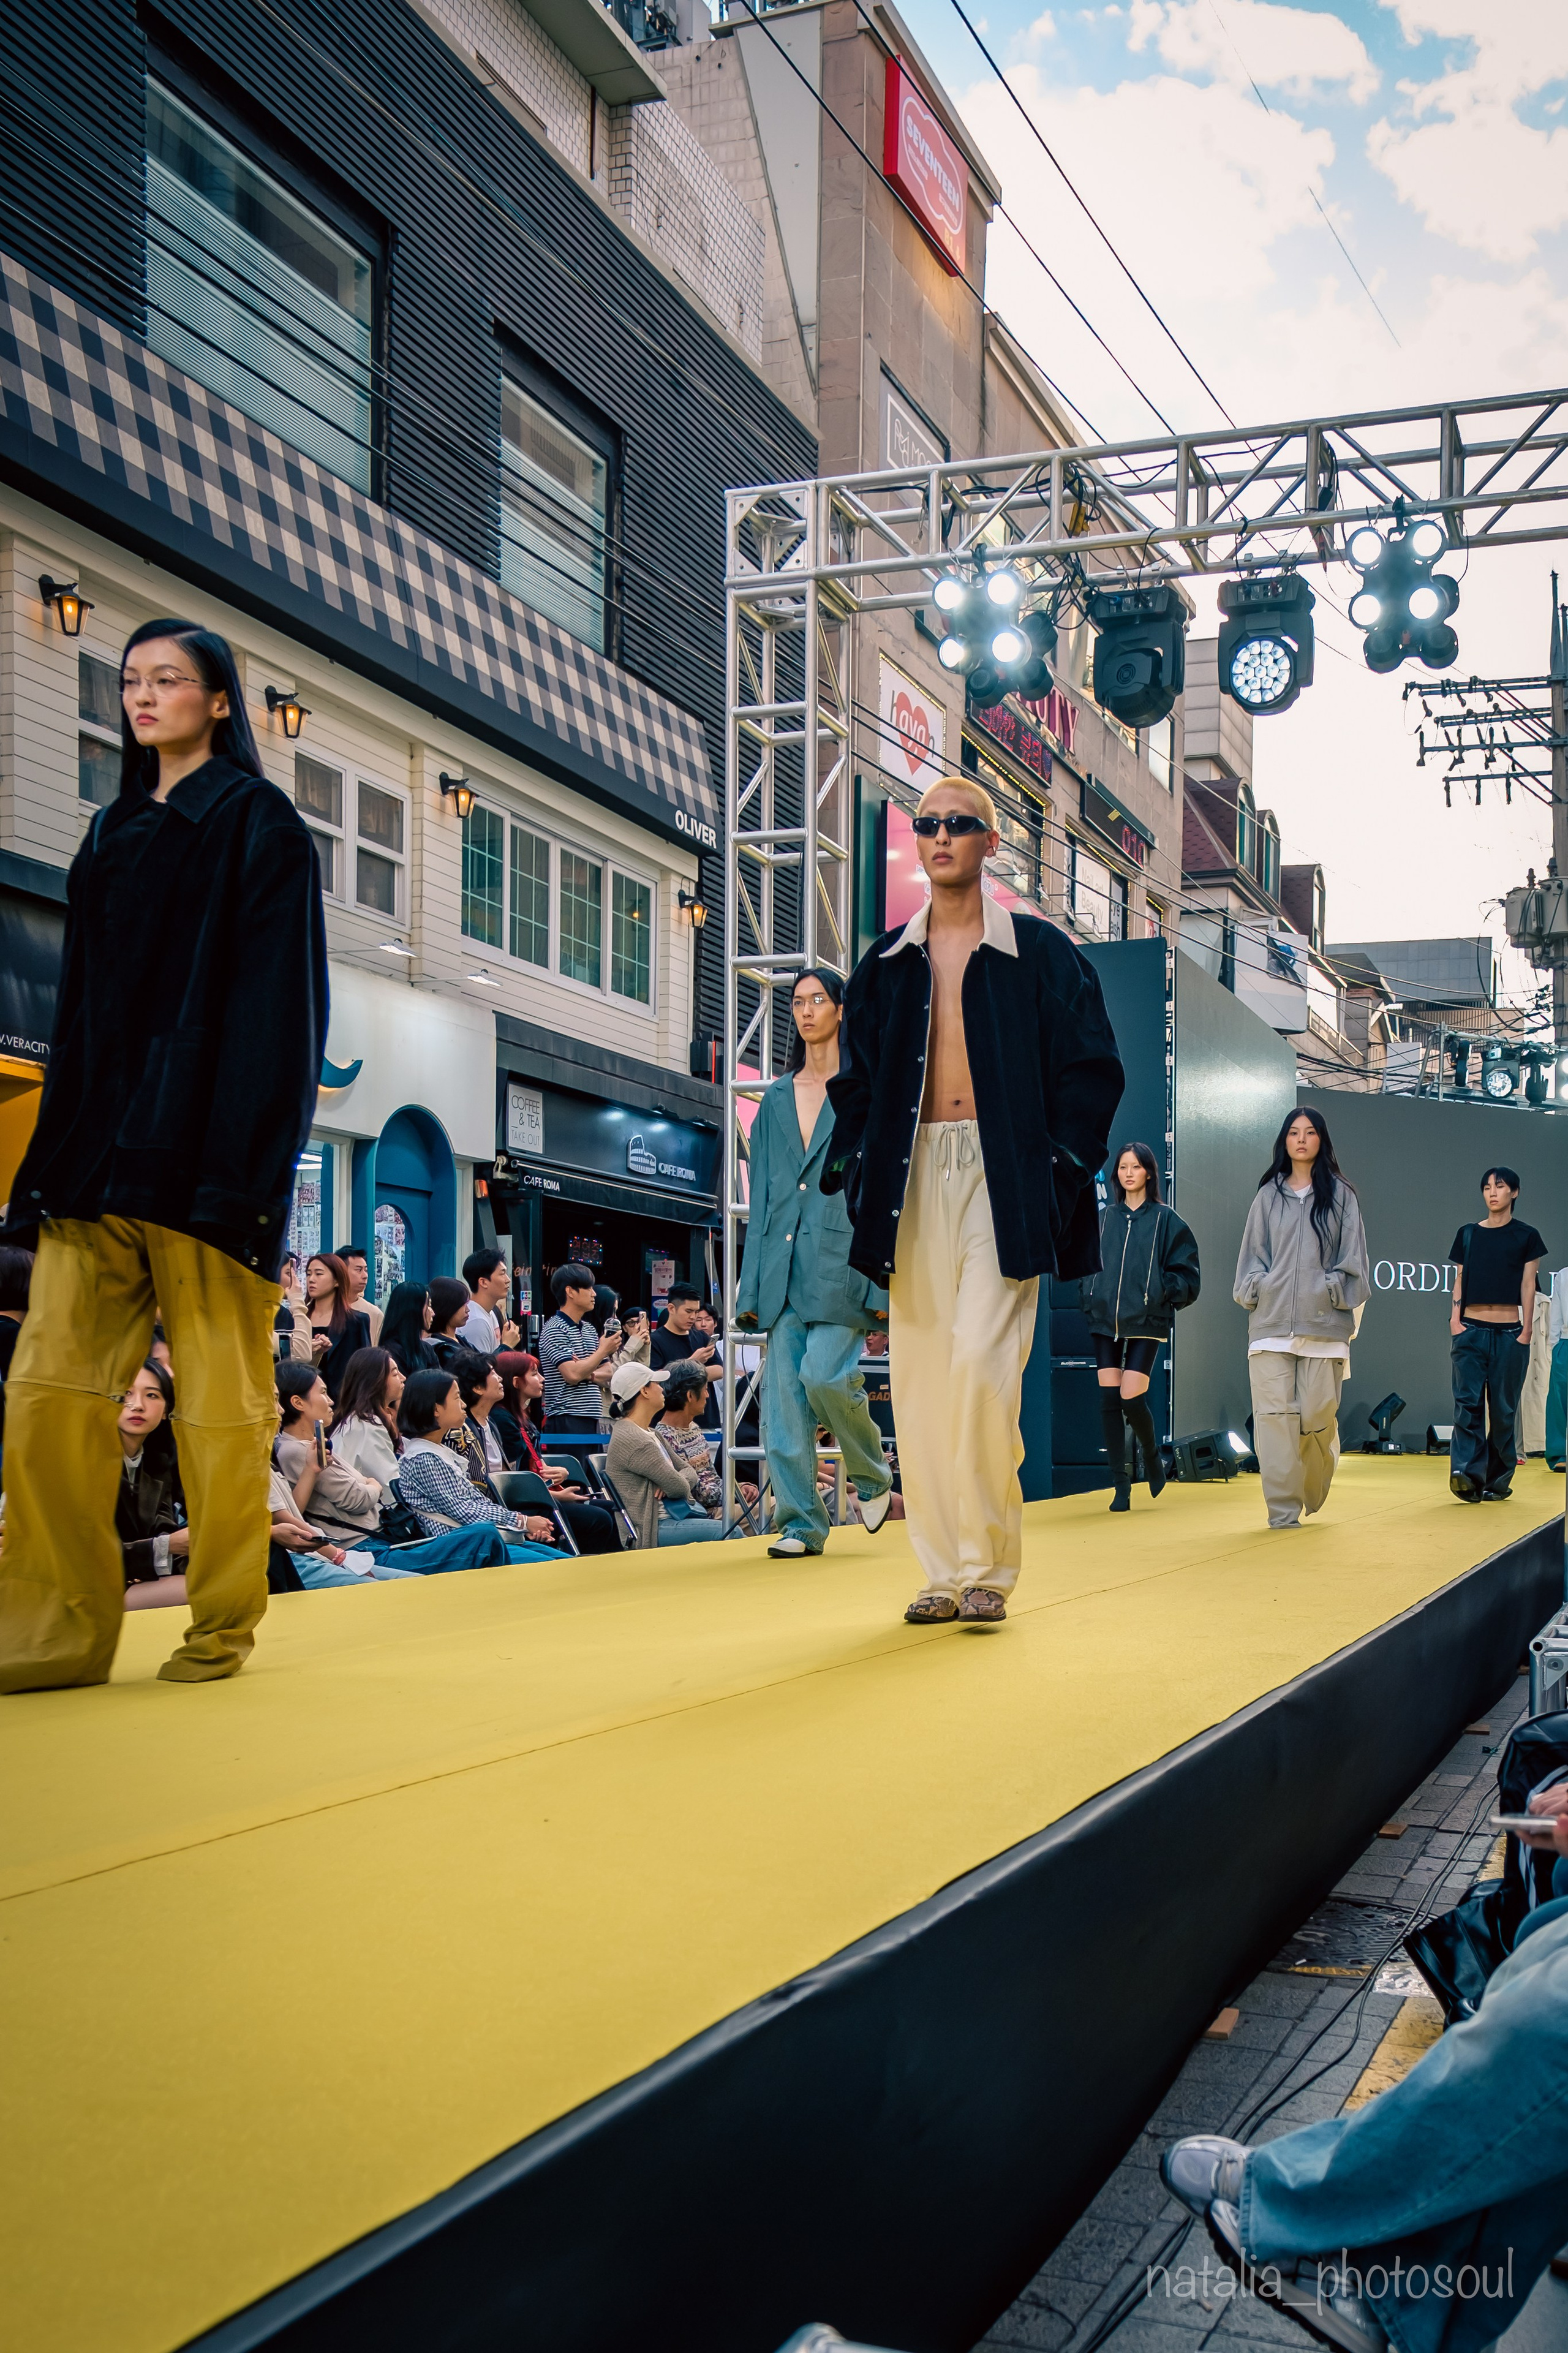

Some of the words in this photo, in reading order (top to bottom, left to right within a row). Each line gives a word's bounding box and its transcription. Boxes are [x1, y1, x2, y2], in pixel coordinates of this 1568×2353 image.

[907, 115, 960, 212] SEVENTEEN
[675, 810, 717, 849] OLIVER
[1082, 866, 1094, 887] Nail
[1081, 890, 1104, 924] Beauty
[511, 1095, 540, 1115] COFFEE
[519, 1112, 525, 1126] &
[527, 1114, 540, 1129] TEA
[511, 1130, 526, 1144] TAKE
[527, 1133, 540, 1146] OUT
[658, 1163, 677, 1177] CAFE
[677, 1166, 696, 1181] ROMA
[524, 1175, 543, 1187] CAFE
[543, 1179, 560, 1192] ROMA
[1374, 1260, 1458, 1293] ORDI
